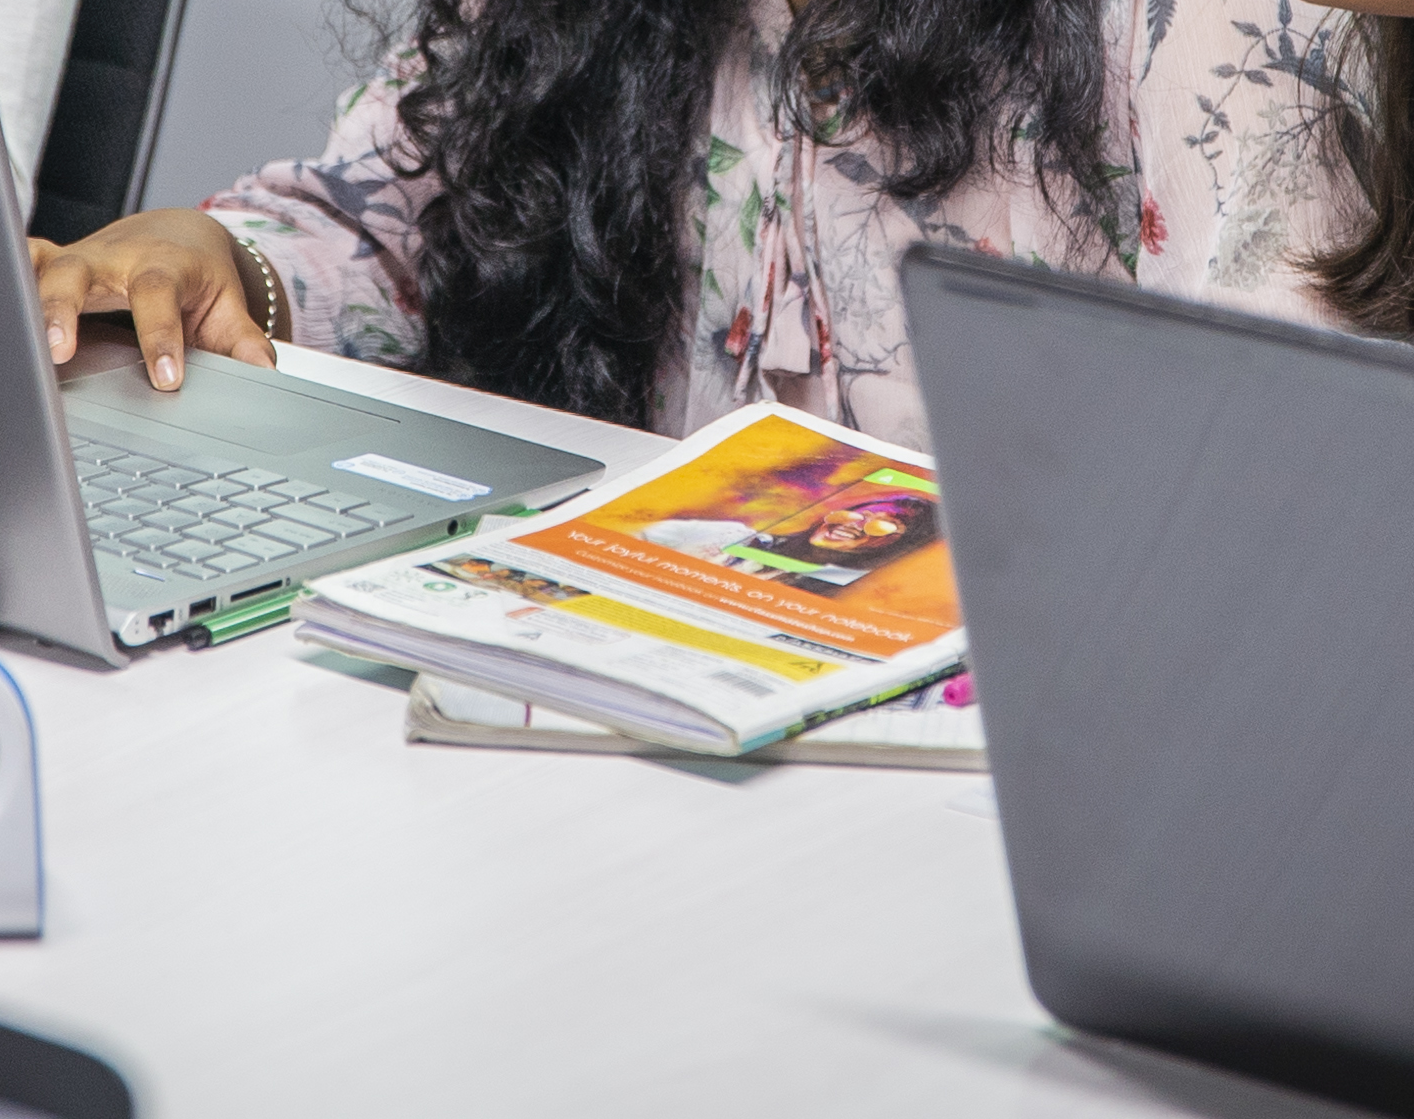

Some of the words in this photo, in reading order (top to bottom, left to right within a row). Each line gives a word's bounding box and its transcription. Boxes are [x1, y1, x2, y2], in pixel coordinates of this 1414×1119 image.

[566, 530, 606, 547] Your
[601, 542, 660, 564] joyful
[656, 561, 743, 594] moments
[746, 589, 775, 603] on
[774, 598, 821, 617] your
[820, 613, 915, 644] notebook
